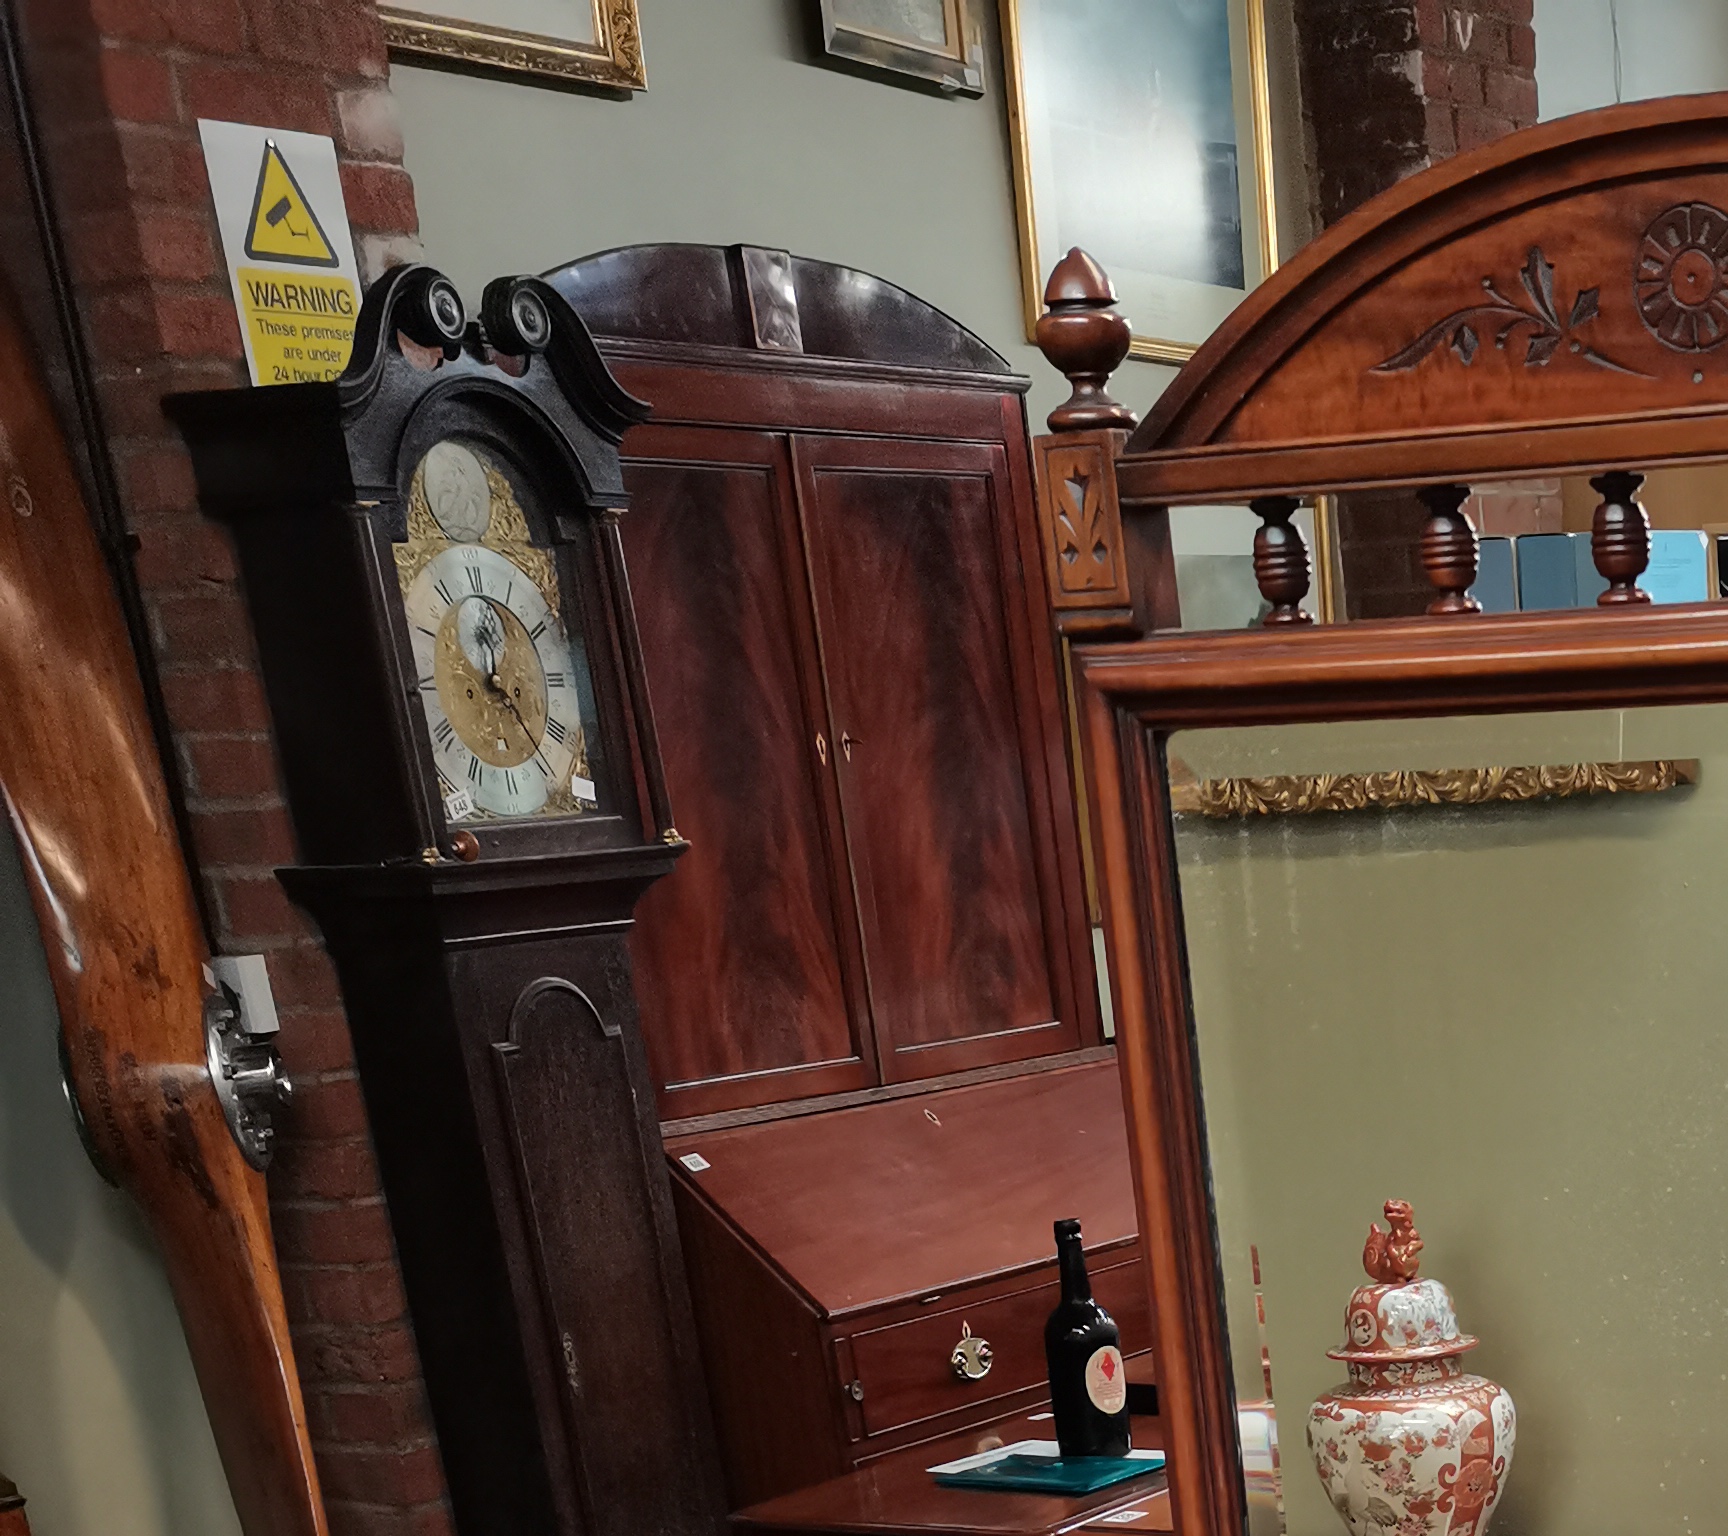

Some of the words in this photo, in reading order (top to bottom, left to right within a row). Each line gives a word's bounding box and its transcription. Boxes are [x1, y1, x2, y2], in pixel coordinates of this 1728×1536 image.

[246, 280, 353, 315] WARNING
[256, 318, 298, 337] These
[284, 346, 303, 360] are
[307, 347, 342, 363] under
[272, 365, 289, 381] 24
